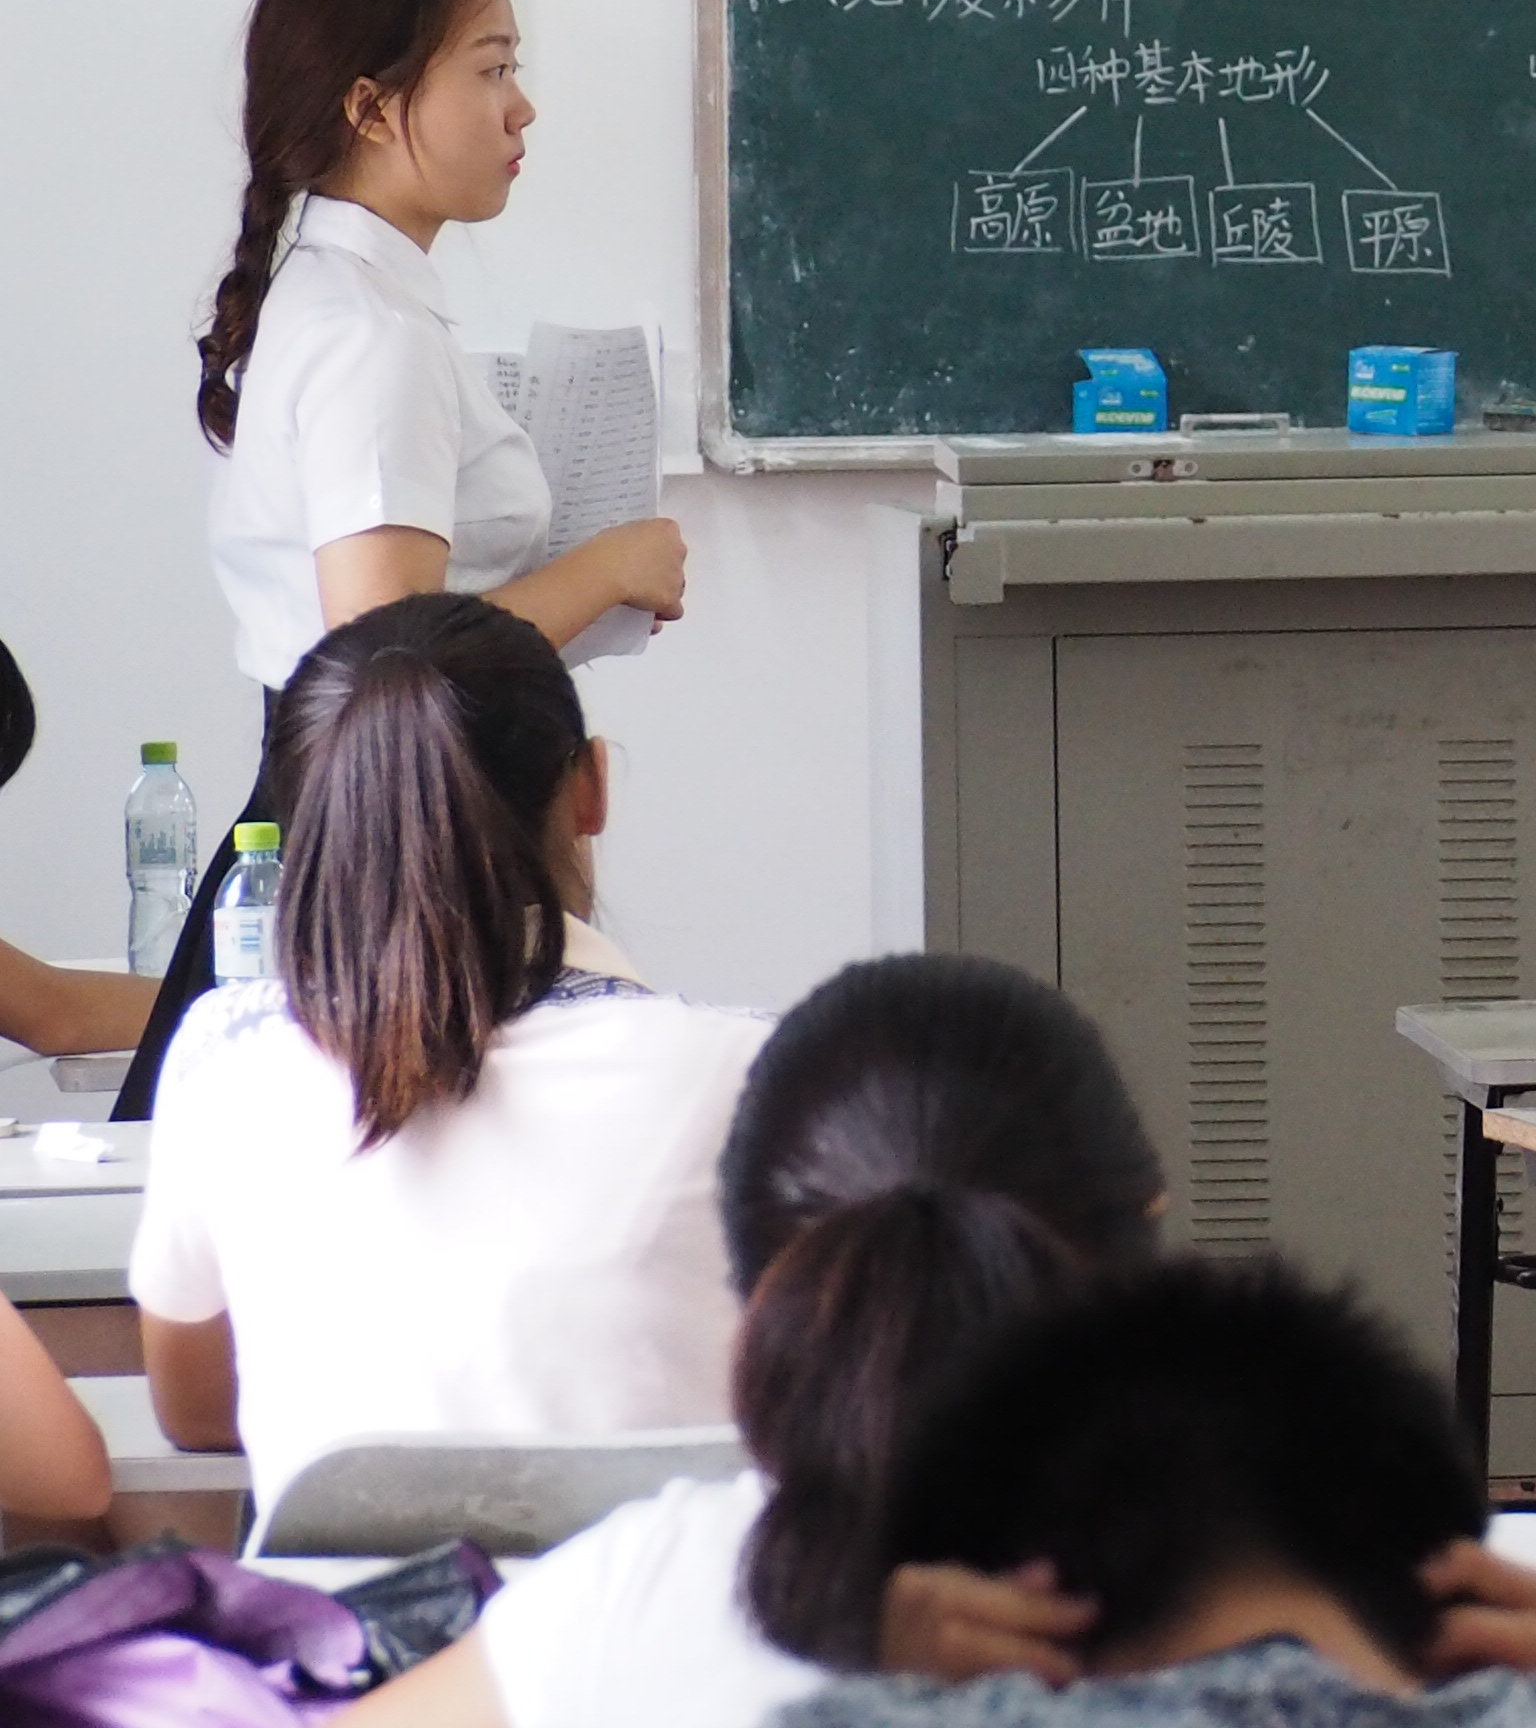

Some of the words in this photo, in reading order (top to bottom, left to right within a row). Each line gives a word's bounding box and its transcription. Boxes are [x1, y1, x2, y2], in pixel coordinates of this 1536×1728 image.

[1036, 39, 1330, 105] 四种基本地形
[967, 176, 1057, 247] 高原
[1094, 189, 1188, 251] 盆地
[1215, 200, 1299, 259] 丘陵
[1361, 210, 1434, 266] 平原
